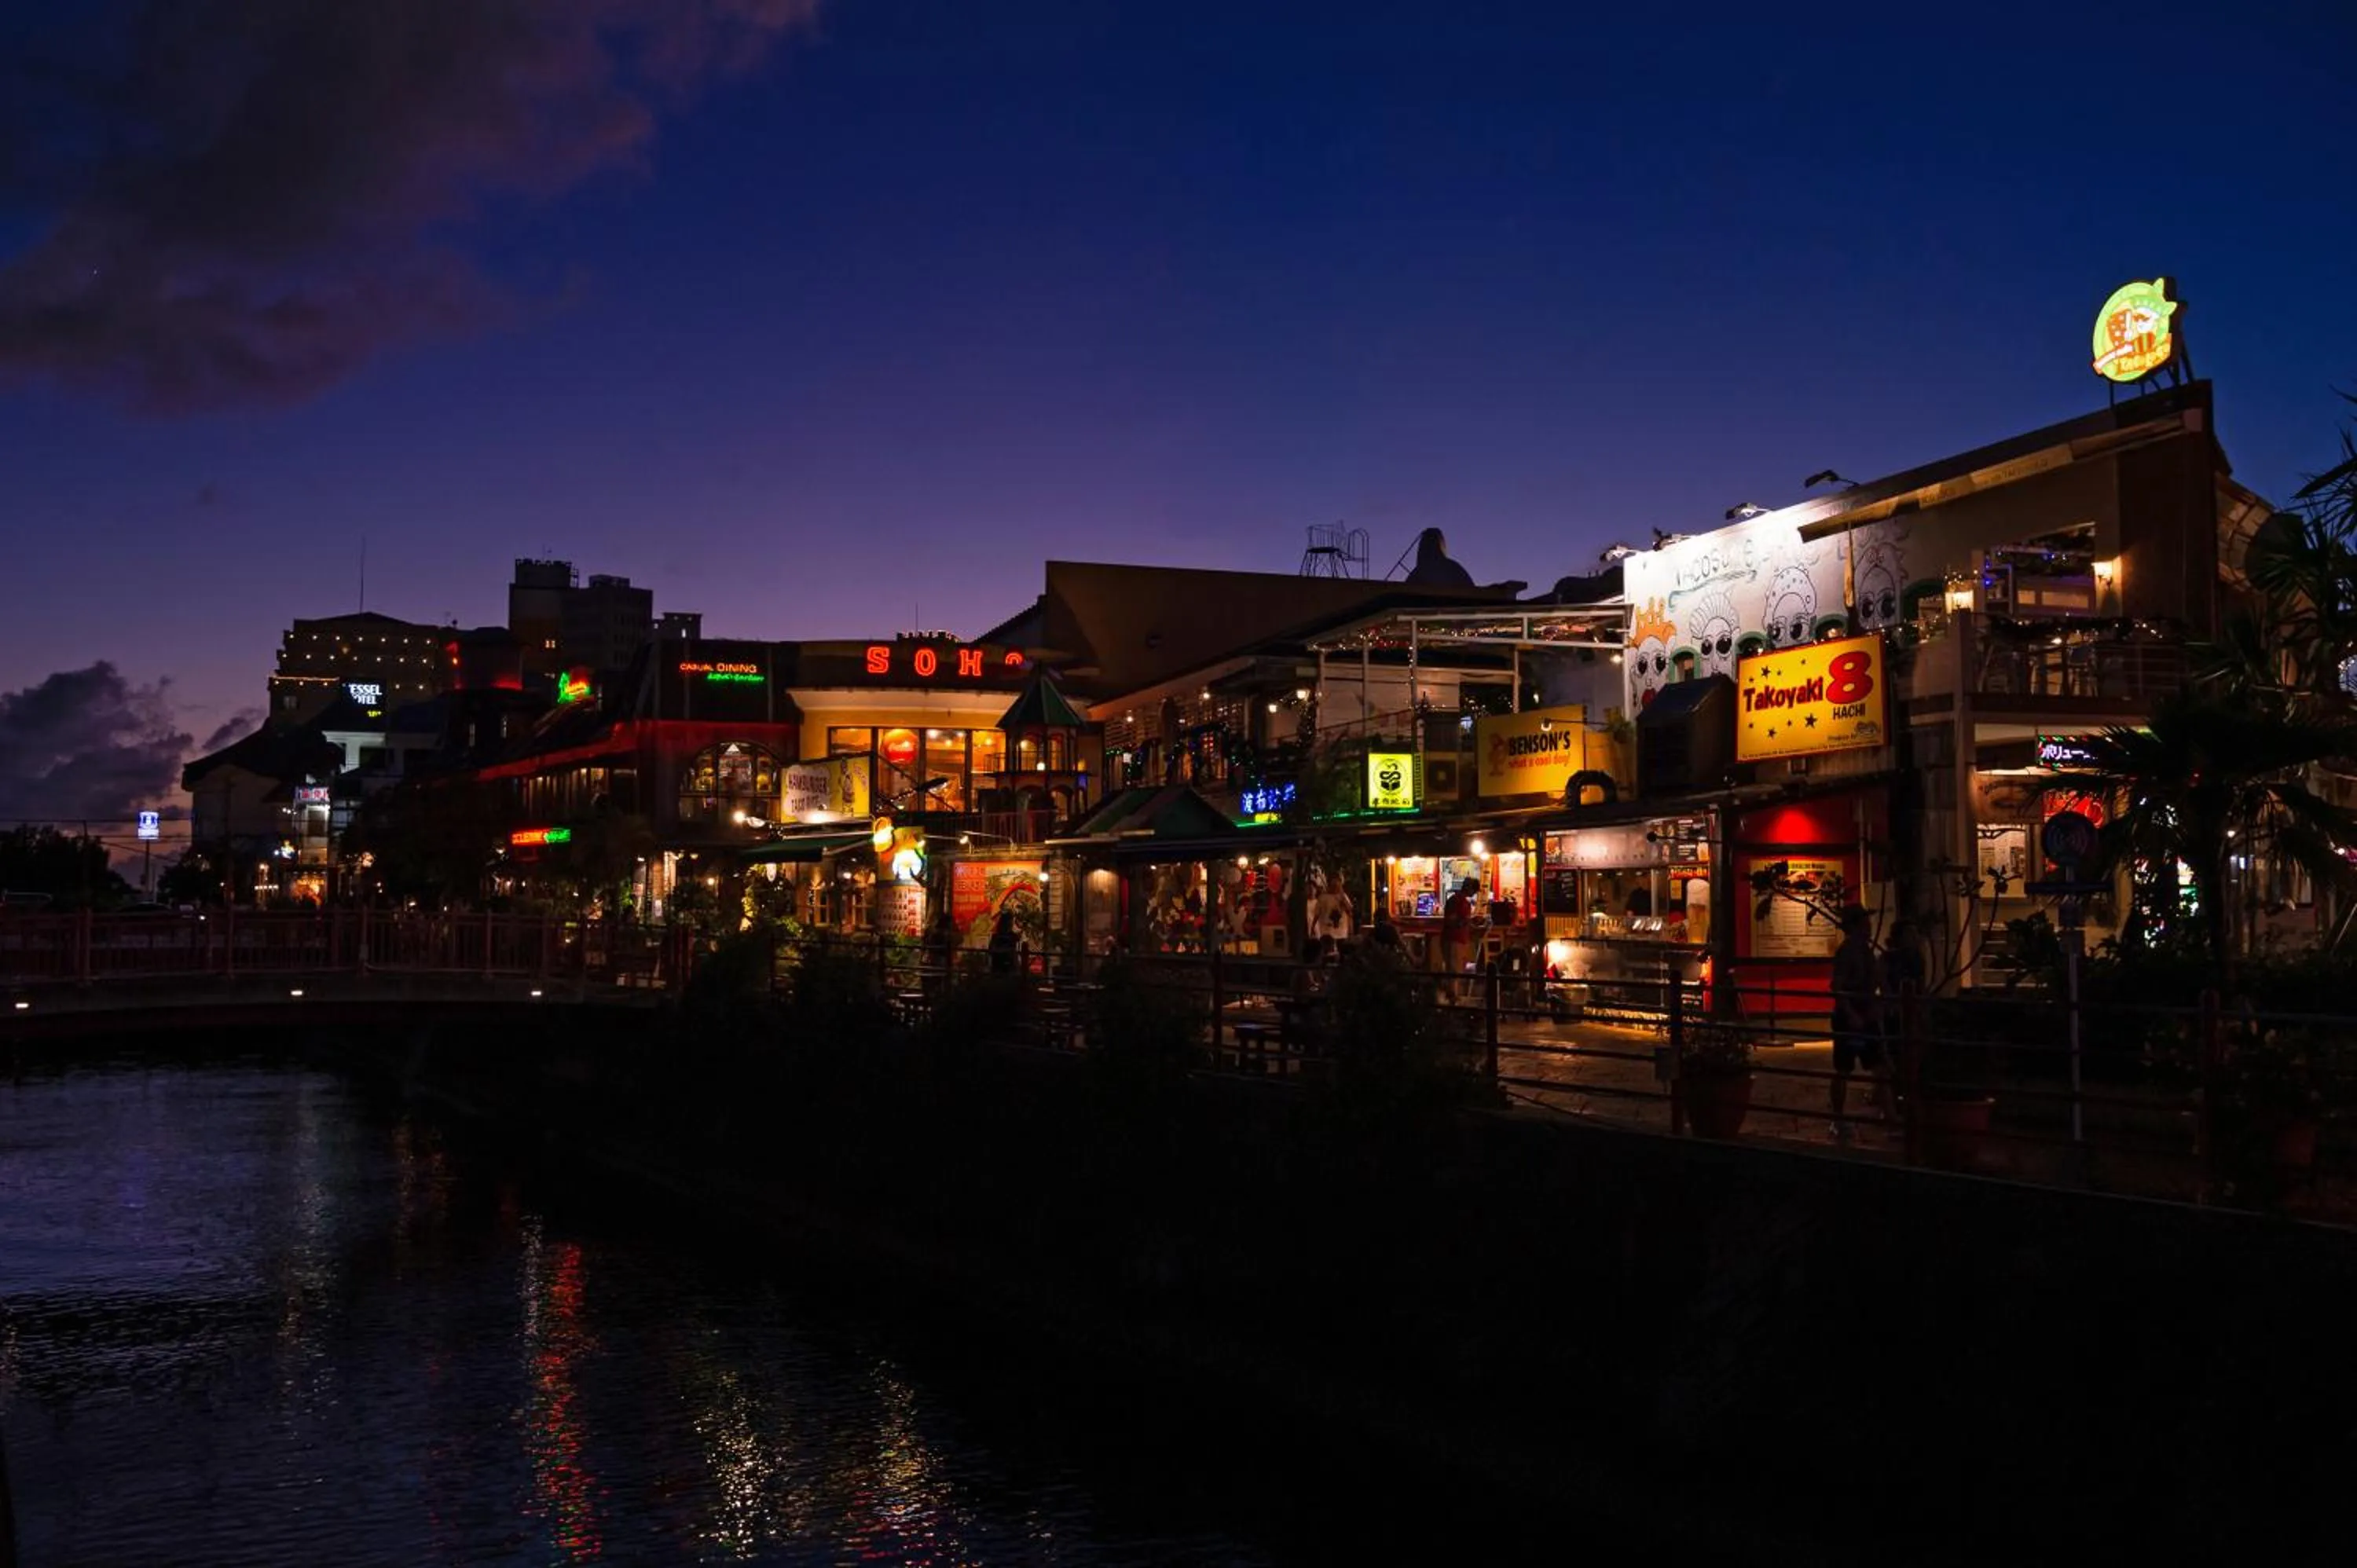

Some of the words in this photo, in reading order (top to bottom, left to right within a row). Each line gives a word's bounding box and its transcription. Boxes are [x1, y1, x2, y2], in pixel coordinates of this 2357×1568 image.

[716, 662, 757, 673] DINING
[1825, 650, 1874, 705] 8
[348, 683, 383, 695] ESSEL
[1832, 704, 1866, 720] HACHI
[1508, 731, 1570, 755] BENSON'S
